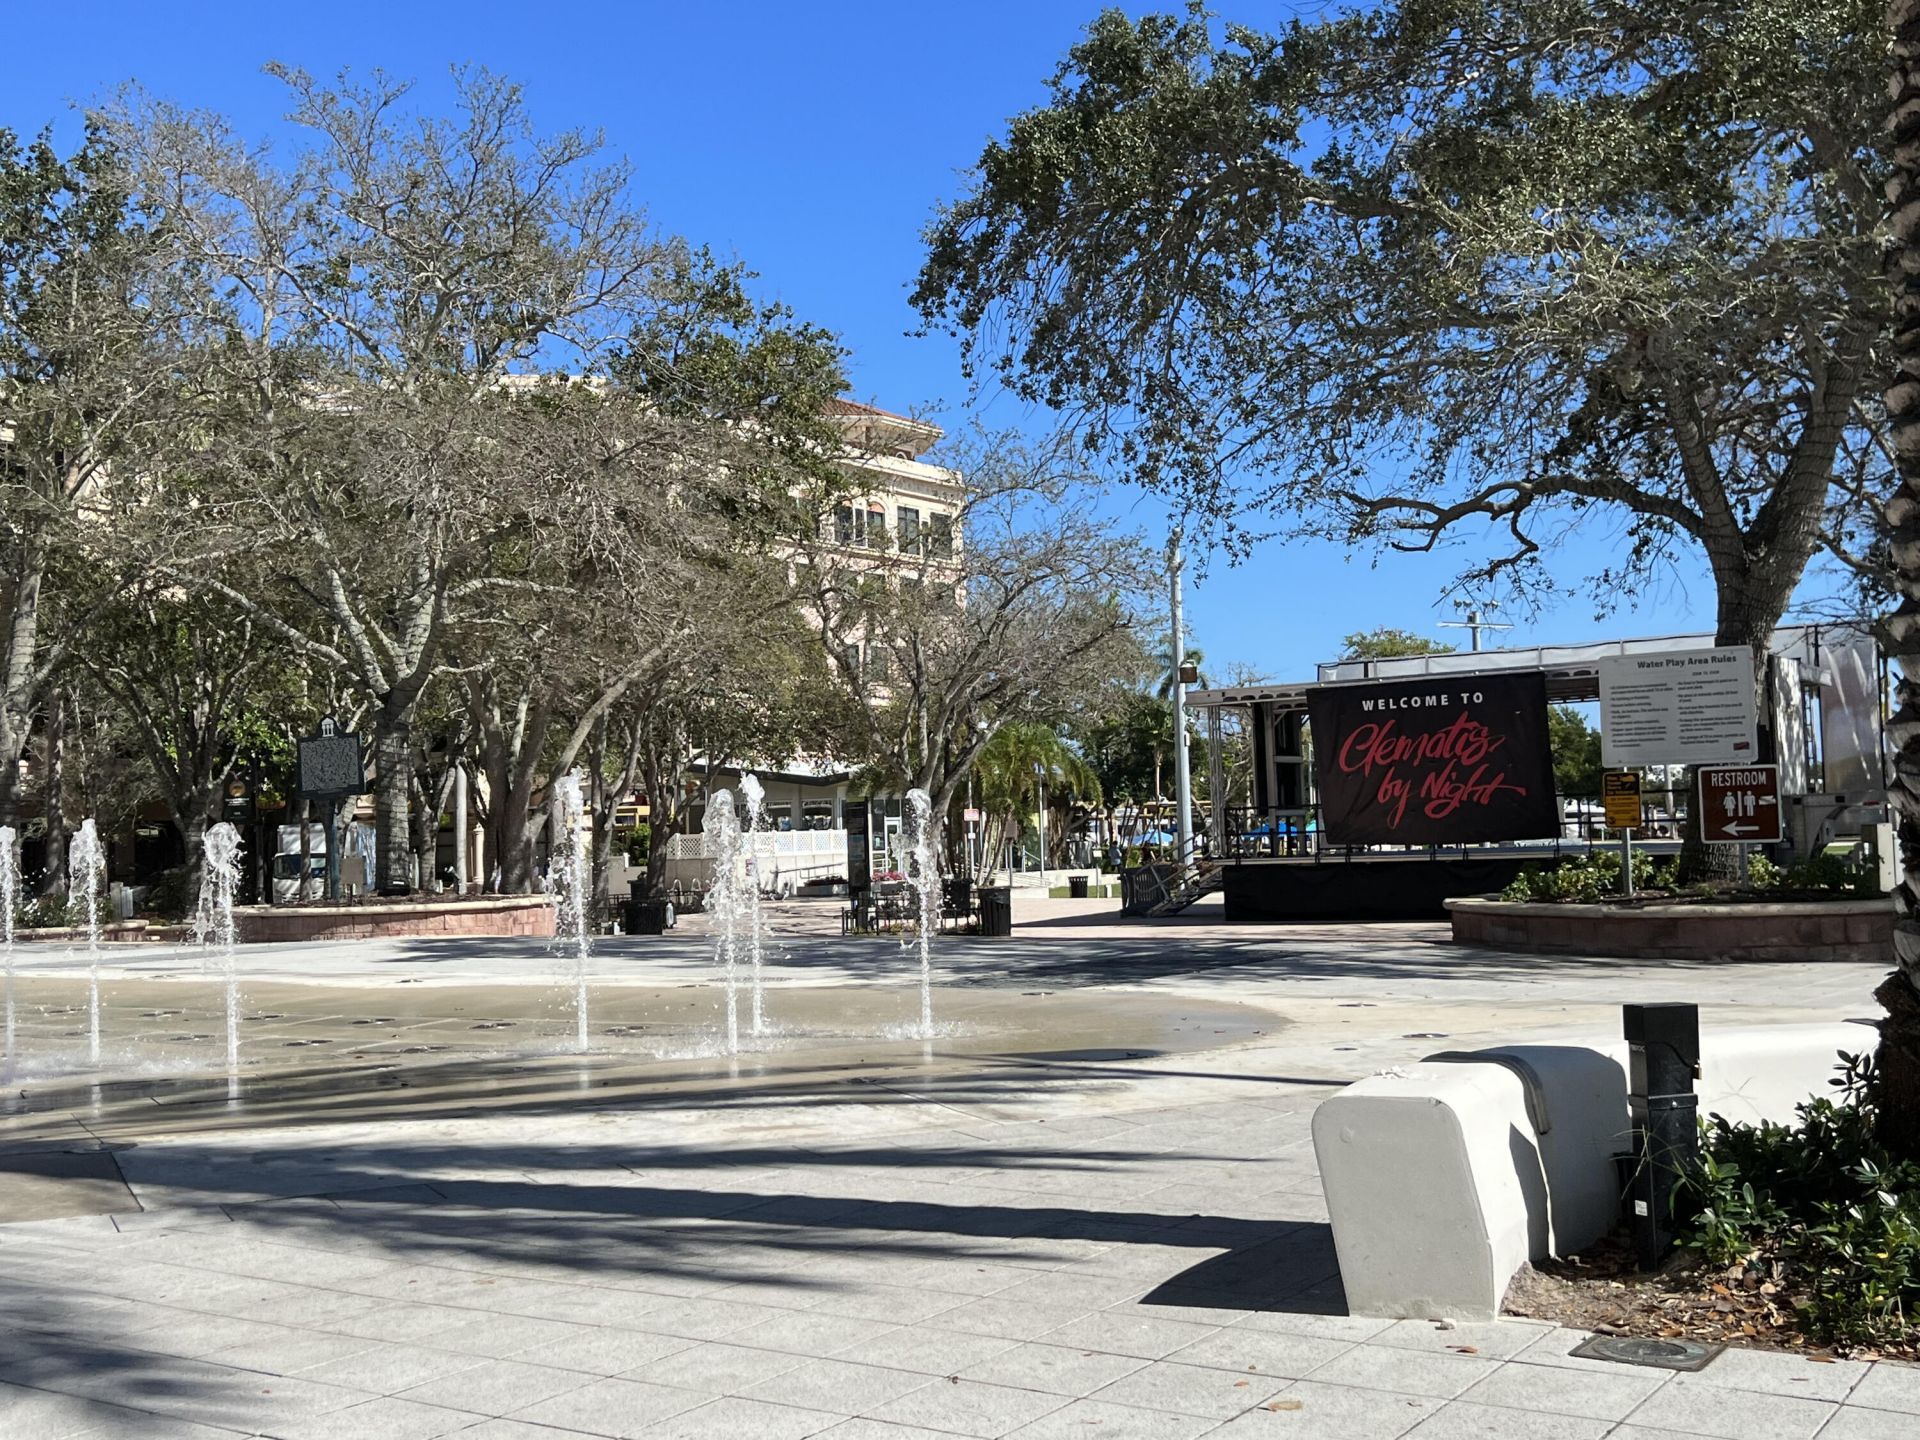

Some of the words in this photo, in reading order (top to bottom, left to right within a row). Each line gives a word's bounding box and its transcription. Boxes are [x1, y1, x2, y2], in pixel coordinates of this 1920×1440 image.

[1637, 661, 1664, 669] Water
[1665, 658, 1685, 668] Play
[1687, 657, 1709, 665] Area
[1711, 655, 1737, 664] Rules
[1362, 694, 1449, 712] WELCOME
[1461, 692, 1483, 704] TO
[1339, 710, 1506, 777] Clematis
[1711, 771, 1767, 787] RESTROOM
[1377, 766, 1412, 830] by
[1420, 758, 1526, 819] Night
